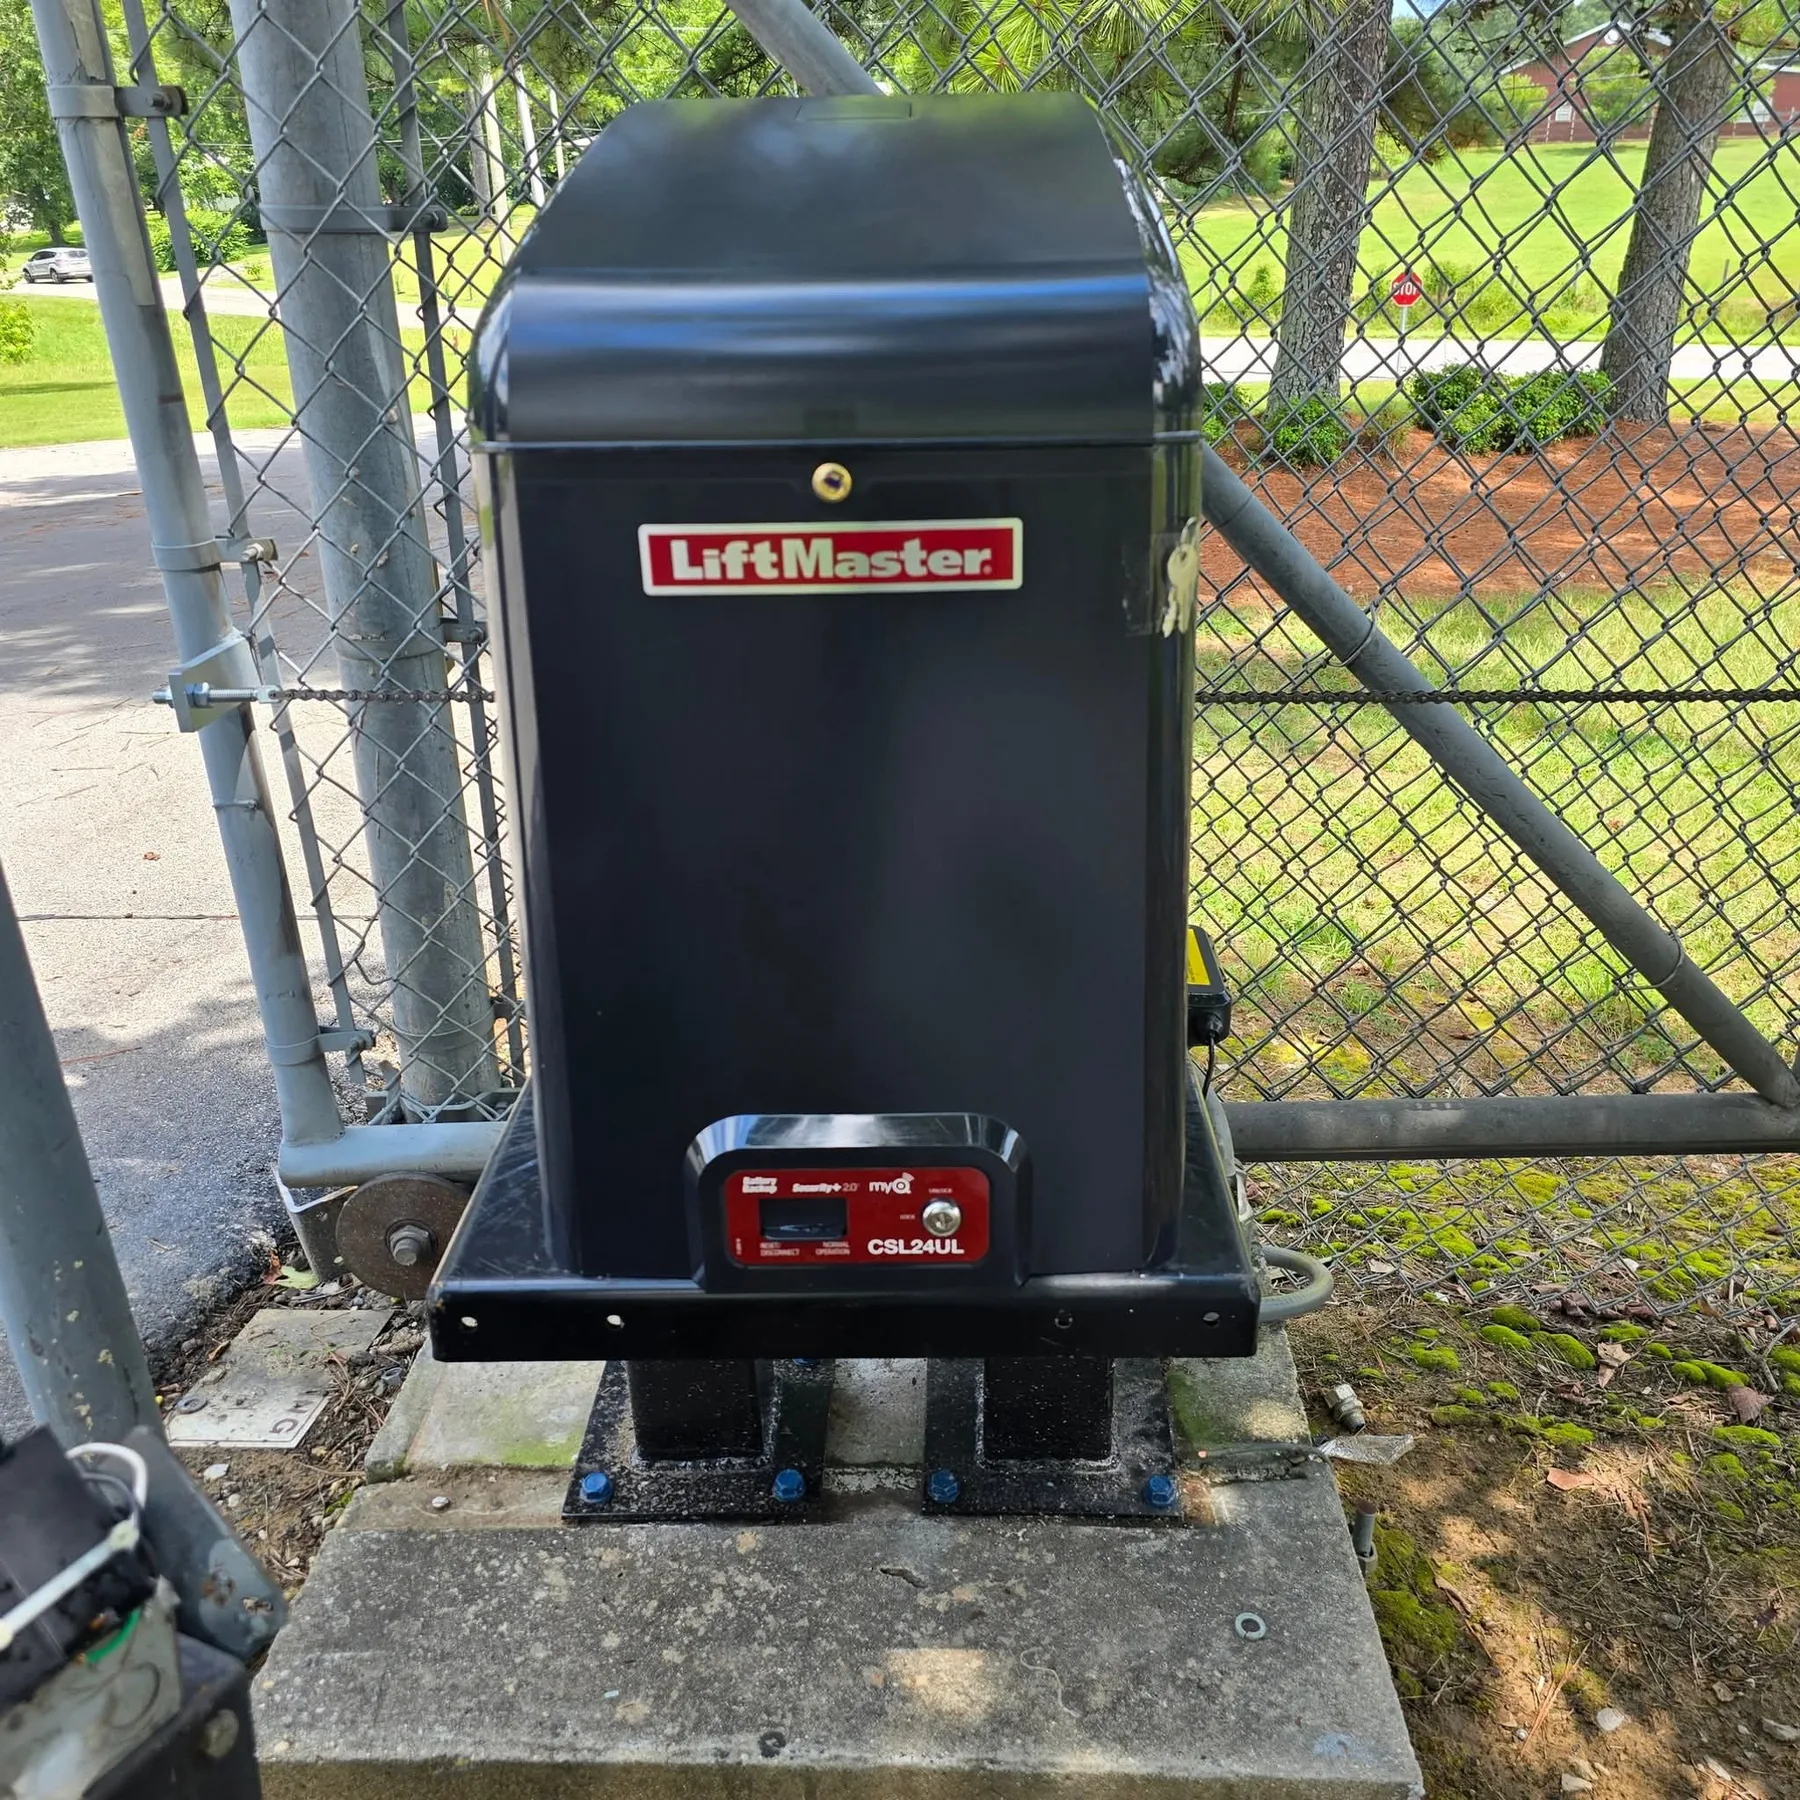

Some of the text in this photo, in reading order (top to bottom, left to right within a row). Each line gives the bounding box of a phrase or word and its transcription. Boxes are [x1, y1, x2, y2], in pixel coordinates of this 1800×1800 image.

[670, 537, 991, 580] LiftMaster
[869, 1177, 912, 1195] myQ
[867, 1238, 965, 1255] CSL24UL
